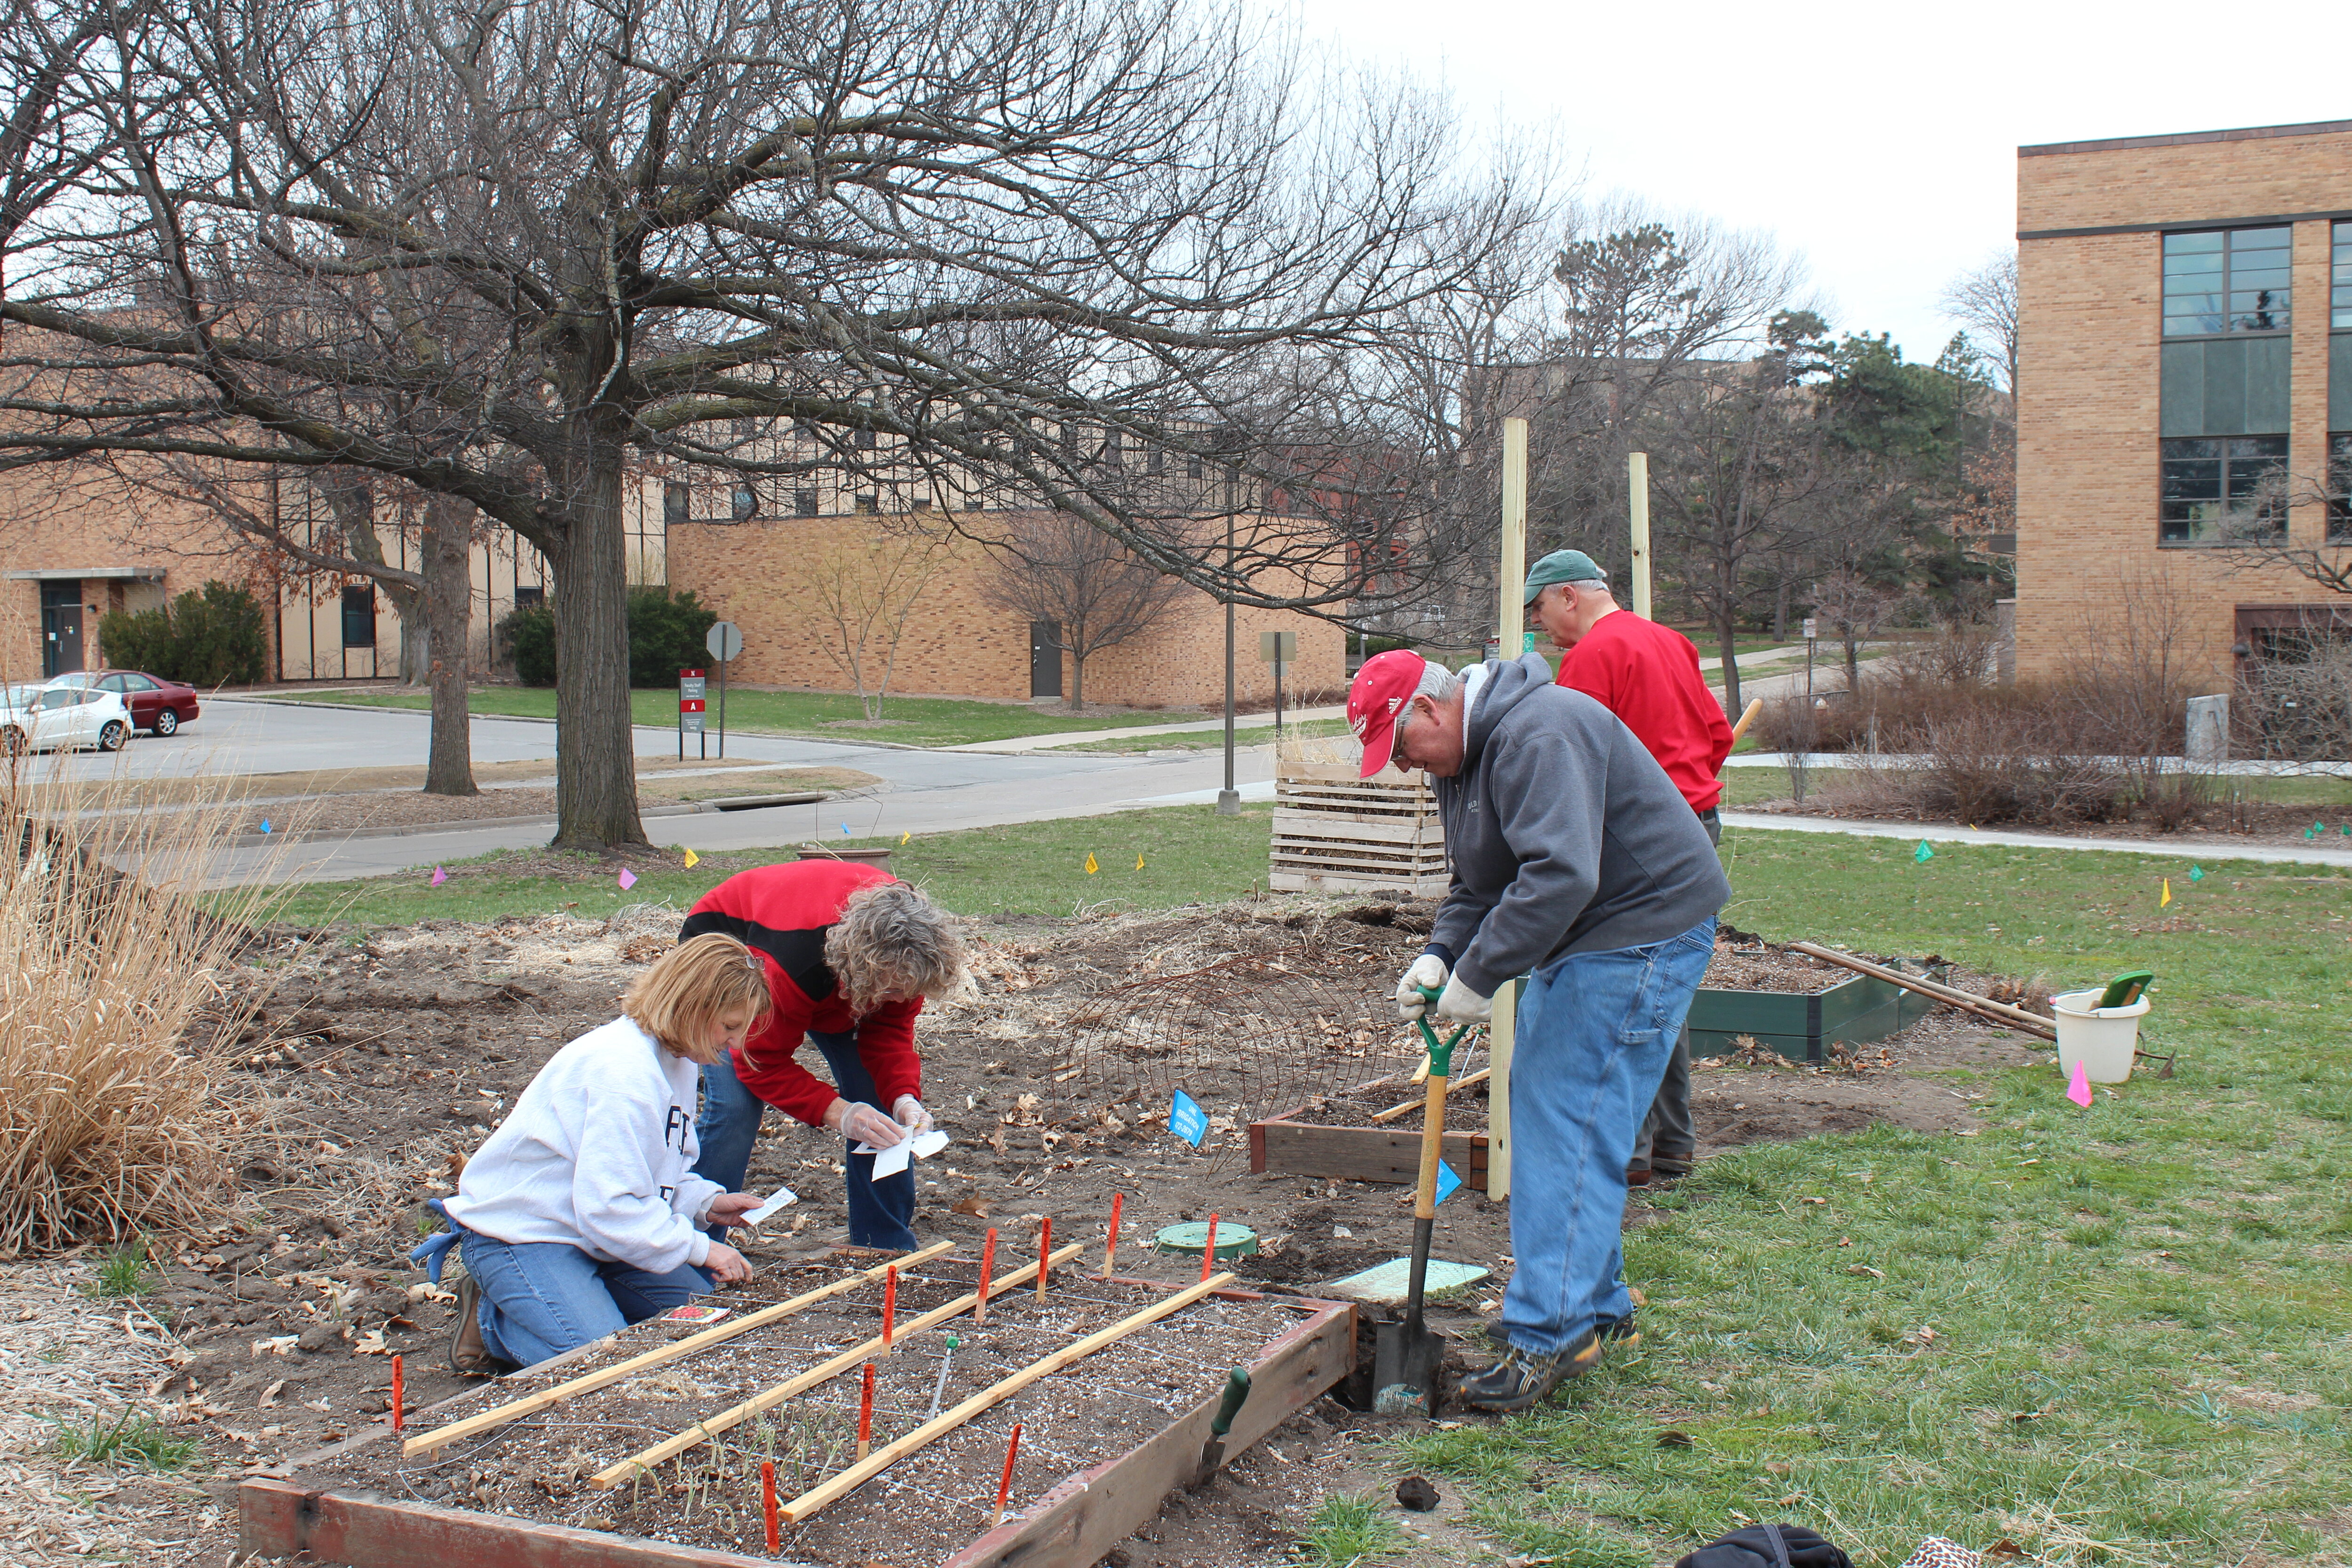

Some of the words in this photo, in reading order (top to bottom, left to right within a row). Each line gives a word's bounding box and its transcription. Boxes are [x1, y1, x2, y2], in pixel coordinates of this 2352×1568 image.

[690, 702, 696, 710] A
[1389, 698, 1402, 714] adidas
[1468, 800, 1477, 810] OLD
[1188, 1105, 1197, 1116] UNL
[1176, 1108, 1200, 1131] IRRIGATION
